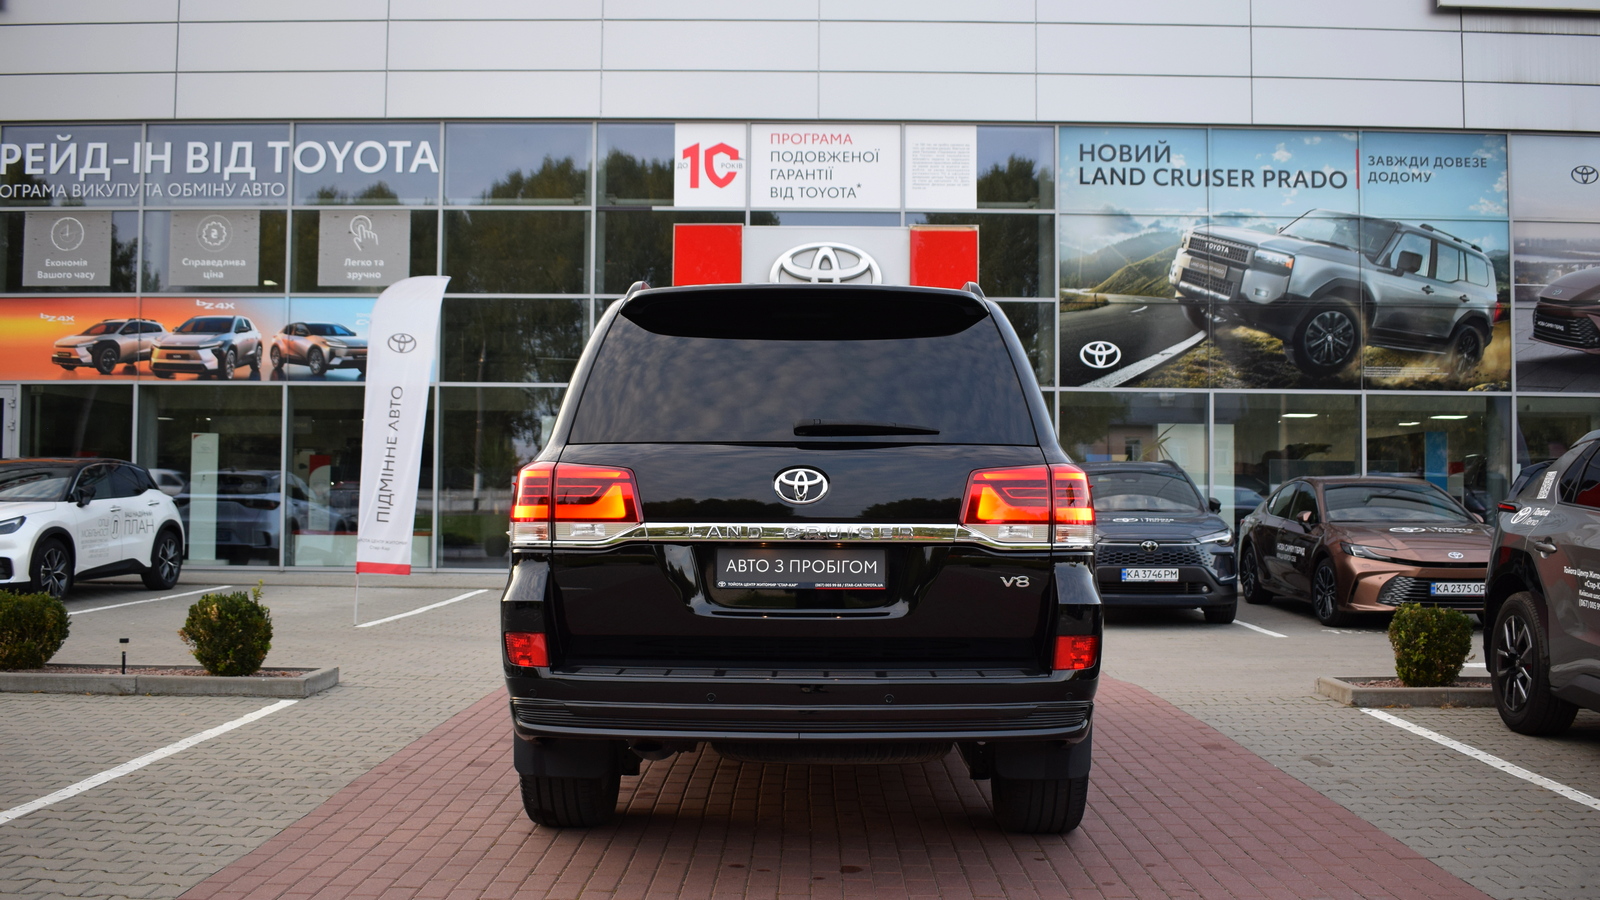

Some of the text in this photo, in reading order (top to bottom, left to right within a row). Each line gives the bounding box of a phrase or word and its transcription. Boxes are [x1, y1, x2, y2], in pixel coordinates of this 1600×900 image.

[770, 133, 853, 145] ПРОГРАМА
[0, 134, 439, 182] РЕЙД-ІН ВІД TOYOTA
[770, 148, 881, 165] ПОДОВЖЕНОЇ
[1079, 140, 1172, 163] НОВИЙ
[1367, 155, 1488, 170] ЗАВЖДИ ДОВЕЗЕ
[770, 166, 835, 180] ГАРАНТІЇ
[1079, 167, 1348, 189] LAND CRUISER PRADO
[1367, 171, 1433, 184] ДОДОМУ
[0, 182, 286, 198] ОГРАМА ВИКУПУ ТА ОБМІНУ АВТО
[770, 186, 795, 201] ВІД
[1205, 242, 1229, 253] TOYOTA
[45, 258, 88, 267] Економія
[182, 257, 246, 268] Справедлива
[343, 258, 372, 267] Легко
[37, 270, 96, 281] Вашого часу
[203, 270, 224, 280] ціна
[346, 271, 382, 281] зручно
[376, 386, 404, 523] ПІДМІННЕ АВТО
[124, 518, 155, 535] ПЛАН
[687, 525, 915, 540] LAND CRUISER
[725, 559, 878, 574] АВТО З ПРОБІГОМ
[1563, 566, 1577, 575] Тойота
[1126, 569, 1178, 579] KA 3746 PM
[999, 575, 1030, 588] V8
[1436, 584, 1450, 593] KA
[1450, 584, 1472, 593] 2375
